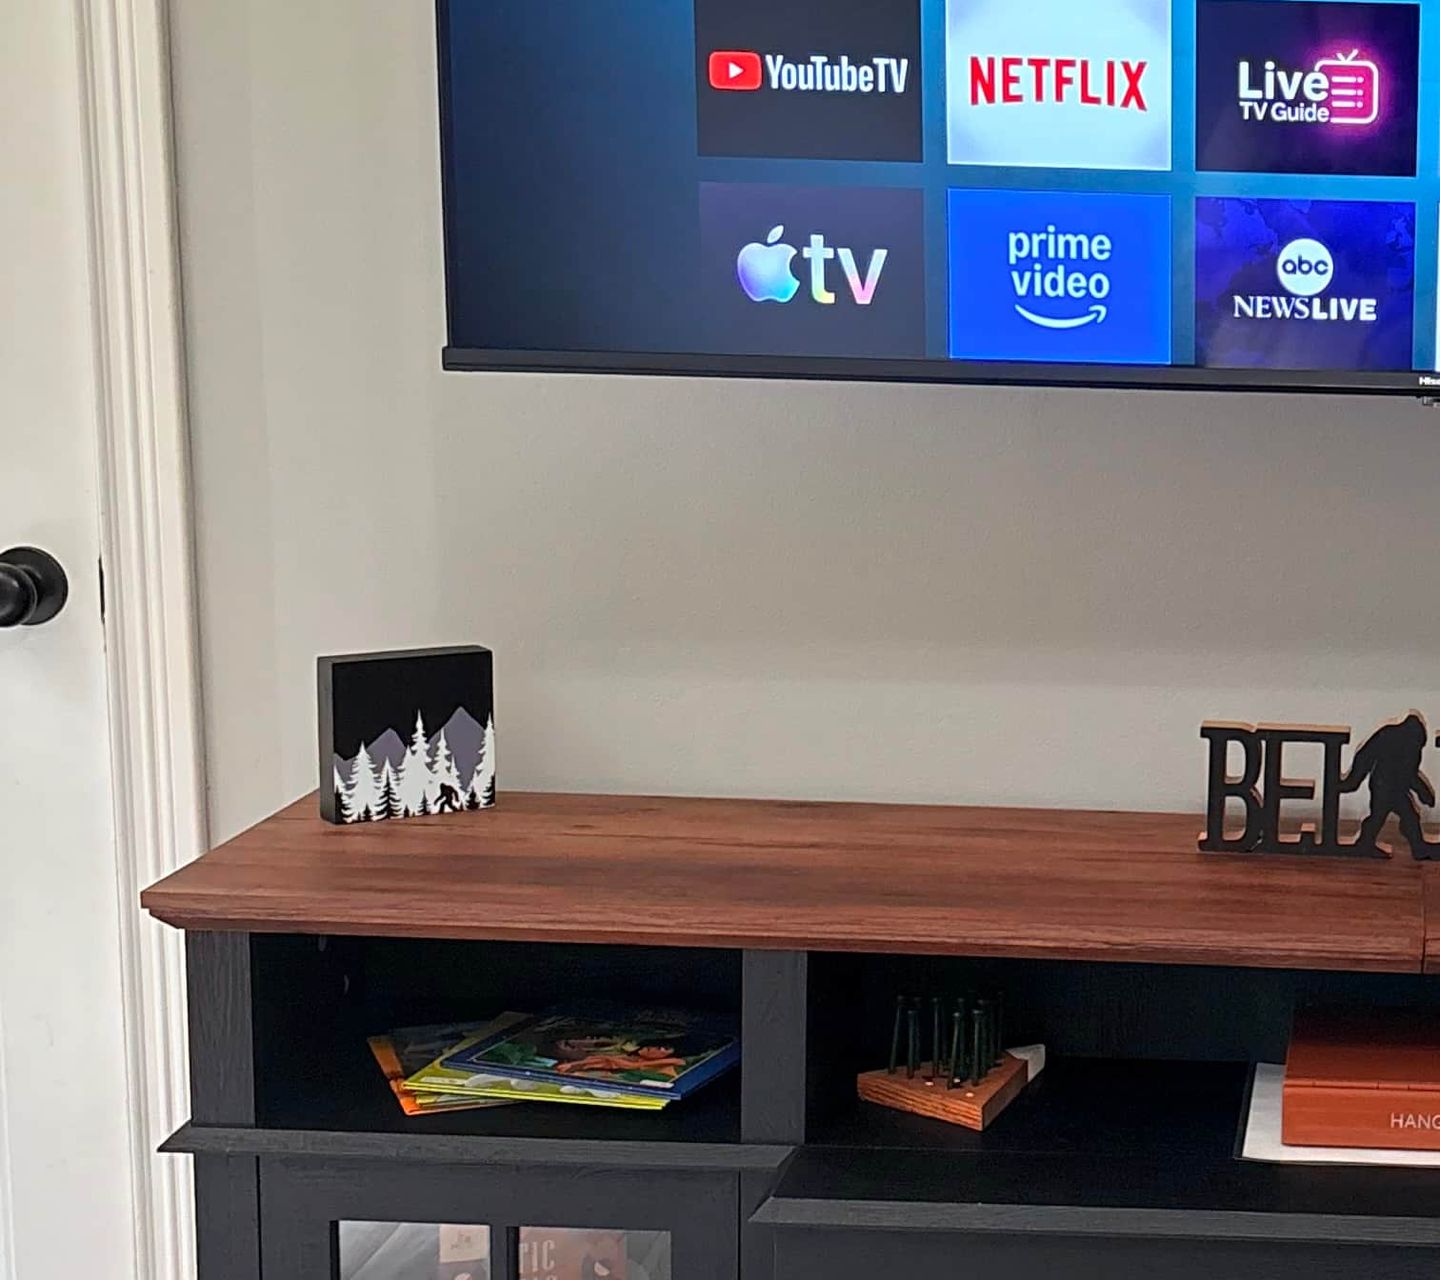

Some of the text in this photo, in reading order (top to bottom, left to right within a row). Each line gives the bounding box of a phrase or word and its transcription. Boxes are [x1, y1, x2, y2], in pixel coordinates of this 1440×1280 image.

[970, 56, 1148, 111] NETFLIX
[1239, 61, 1329, 102] Live
[1240, 102, 1330, 123] TV Guide
[1008, 225, 1112, 266] prime
[803, 234, 887, 305] tv
[1010, 265, 1110, 299] video
[1281, 256, 1329, 277] abc
